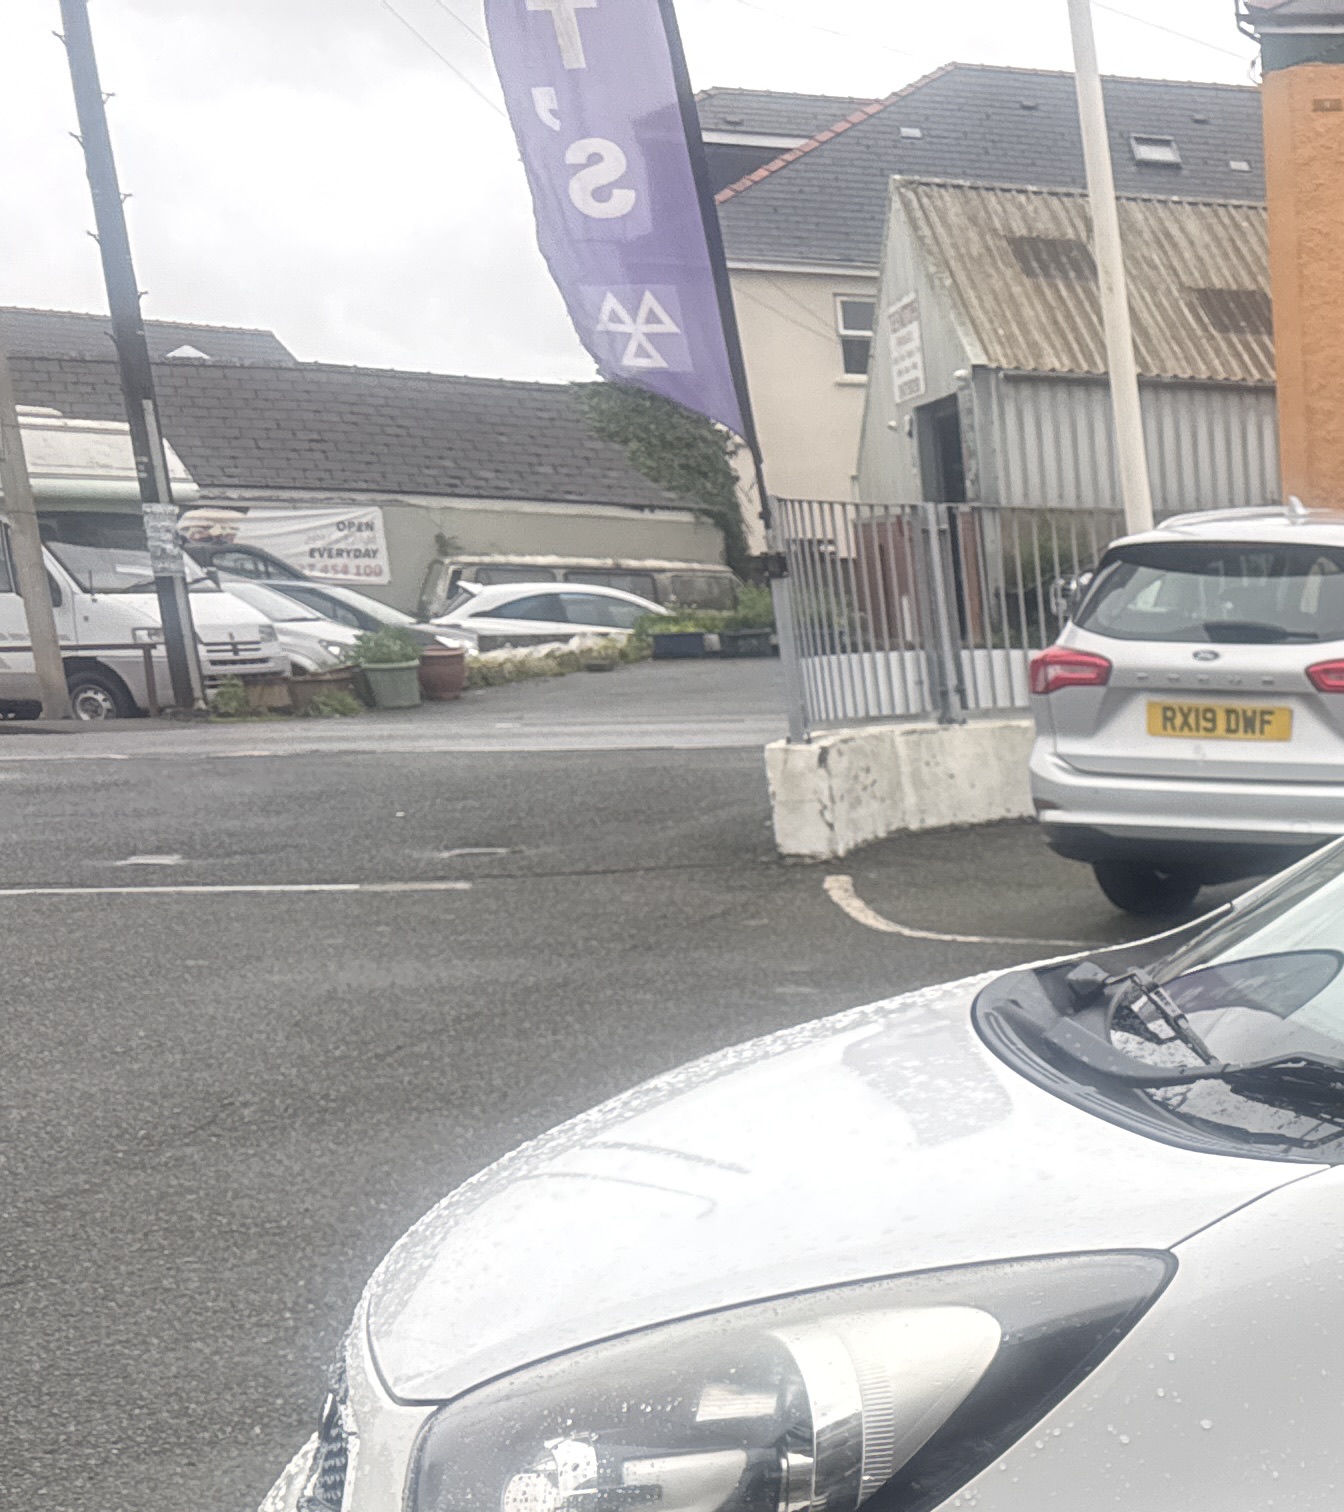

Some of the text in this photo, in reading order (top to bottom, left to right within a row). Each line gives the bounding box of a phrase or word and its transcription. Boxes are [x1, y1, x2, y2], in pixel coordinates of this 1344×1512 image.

[336, 520, 375, 532] OPEN
[308, 547, 379, 559] EVERYDAY
[1161, 706, 1275, 735] RX19 DWF
